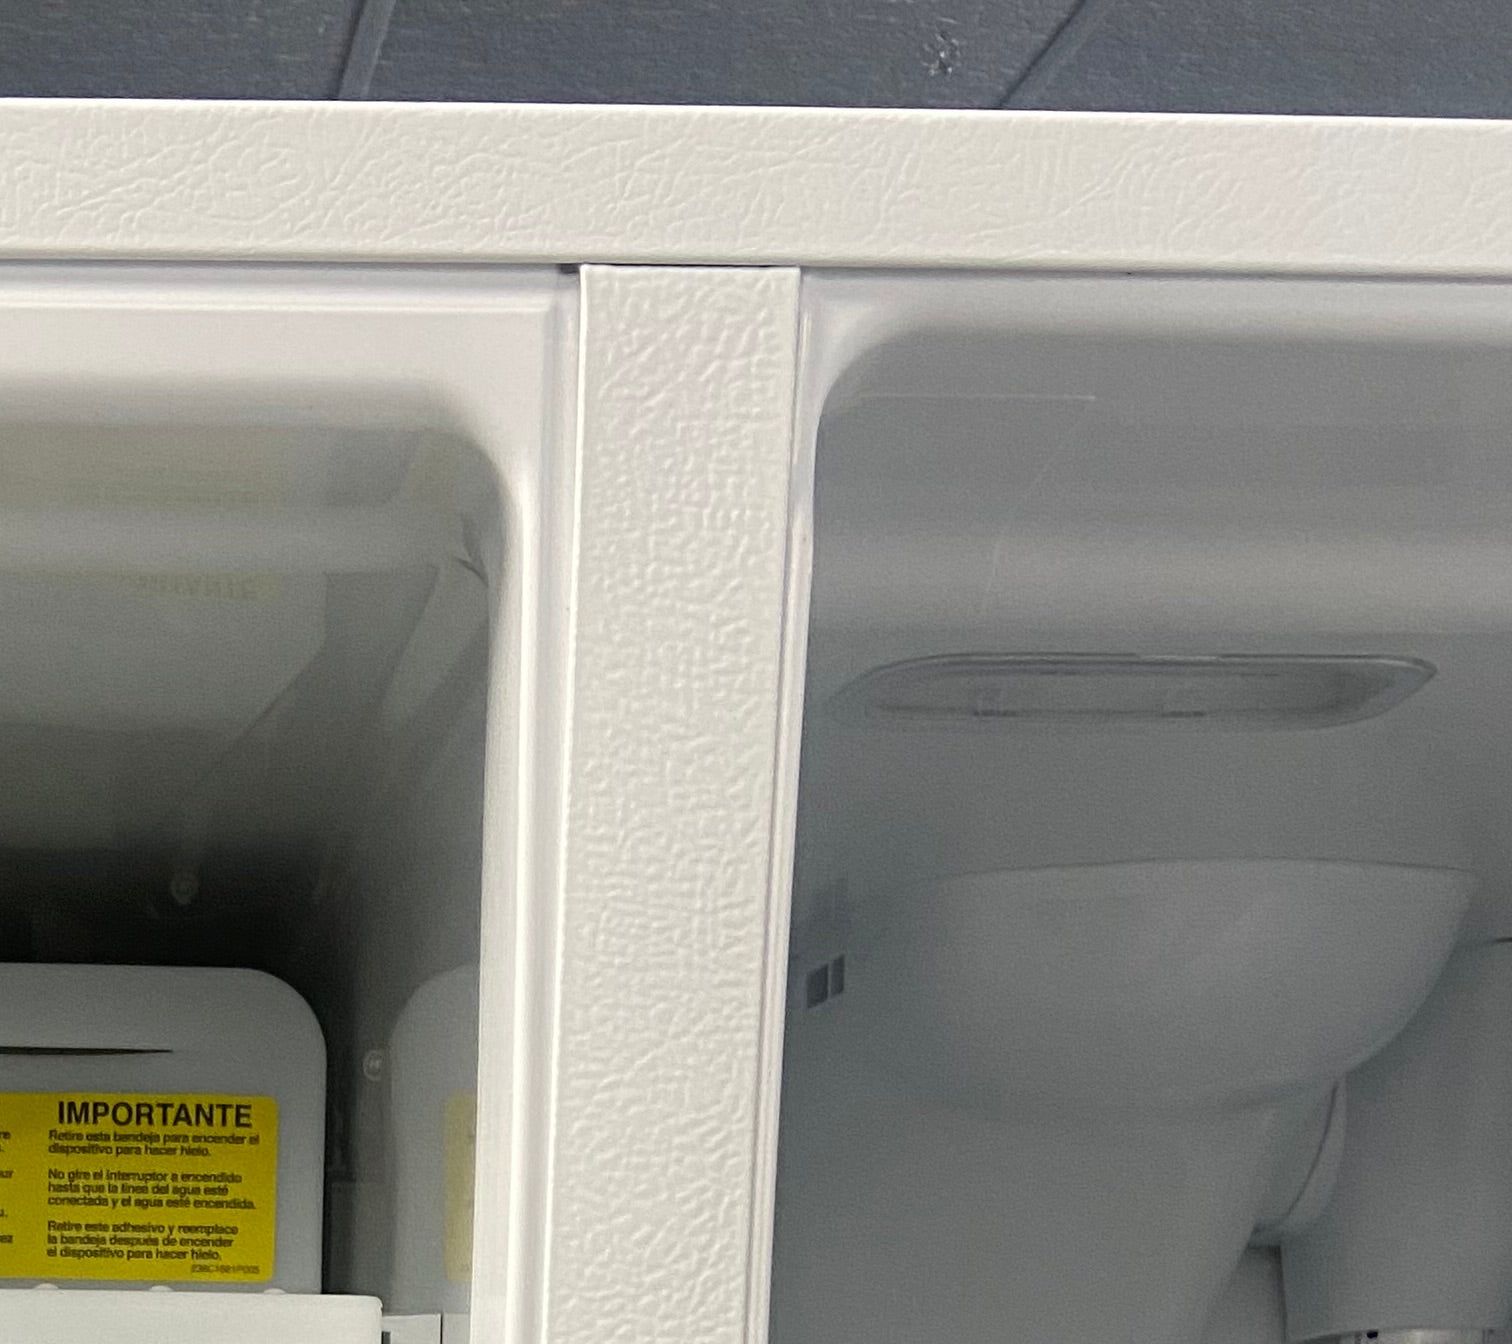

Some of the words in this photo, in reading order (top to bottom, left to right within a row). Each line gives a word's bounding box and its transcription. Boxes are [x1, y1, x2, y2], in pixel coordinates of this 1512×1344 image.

[58, 1101, 252, 1127] IMPORTANTE
[48, 1130, 83, 1141] Retire
[113, 1132, 160, 1145] bandeja
[163, 1134, 189, 1145] para
[192, 1133, 246, 1144] encender
[249, 1134, 260, 1144] el
[48, 1144, 113, 1157] dispositivo
[115, 1147, 141, 1157] para
[144, 1145, 177, 1155] hacer
[48, 1169, 65, 1179] No
[67, 1169, 90, 1182] gire
[92, 1170, 103, 1180] el
[106, 1170, 168, 1184] interruptor
[170, 1173, 178, 1181] a
[48, 1182, 80, 1193] hasta
[82, 1185, 105, 1195] que
[108, 1183, 118, 1193] la
[151, 1184, 169, 1194] del
[172, 1186, 201, 1197] agua
[47, 1196, 109, 1207] conectada
[111, 1199, 118, 1209] y
[121, 1197, 132, 1207] el
[134, 1199, 163, 1210] agua
[47, 1221, 82, 1231] Retire
[112, 1222, 165, 1233] adhesivo
[168, 1225, 174, 1236] y
[178, 1223, 238, 1237] reemplace
[47, 1234, 58, 1244] la
[60, 1235, 107, 1247] bandeja
[162, 1236, 177, 1246] de
[179, 1236, 234, 1247] encender
[46, 1248, 57, 1257] el
[60, 1248, 124, 1261] dispositivo
[126, 1251, 153, 1261] para
[155, 1249, 188, 1260] hacer
